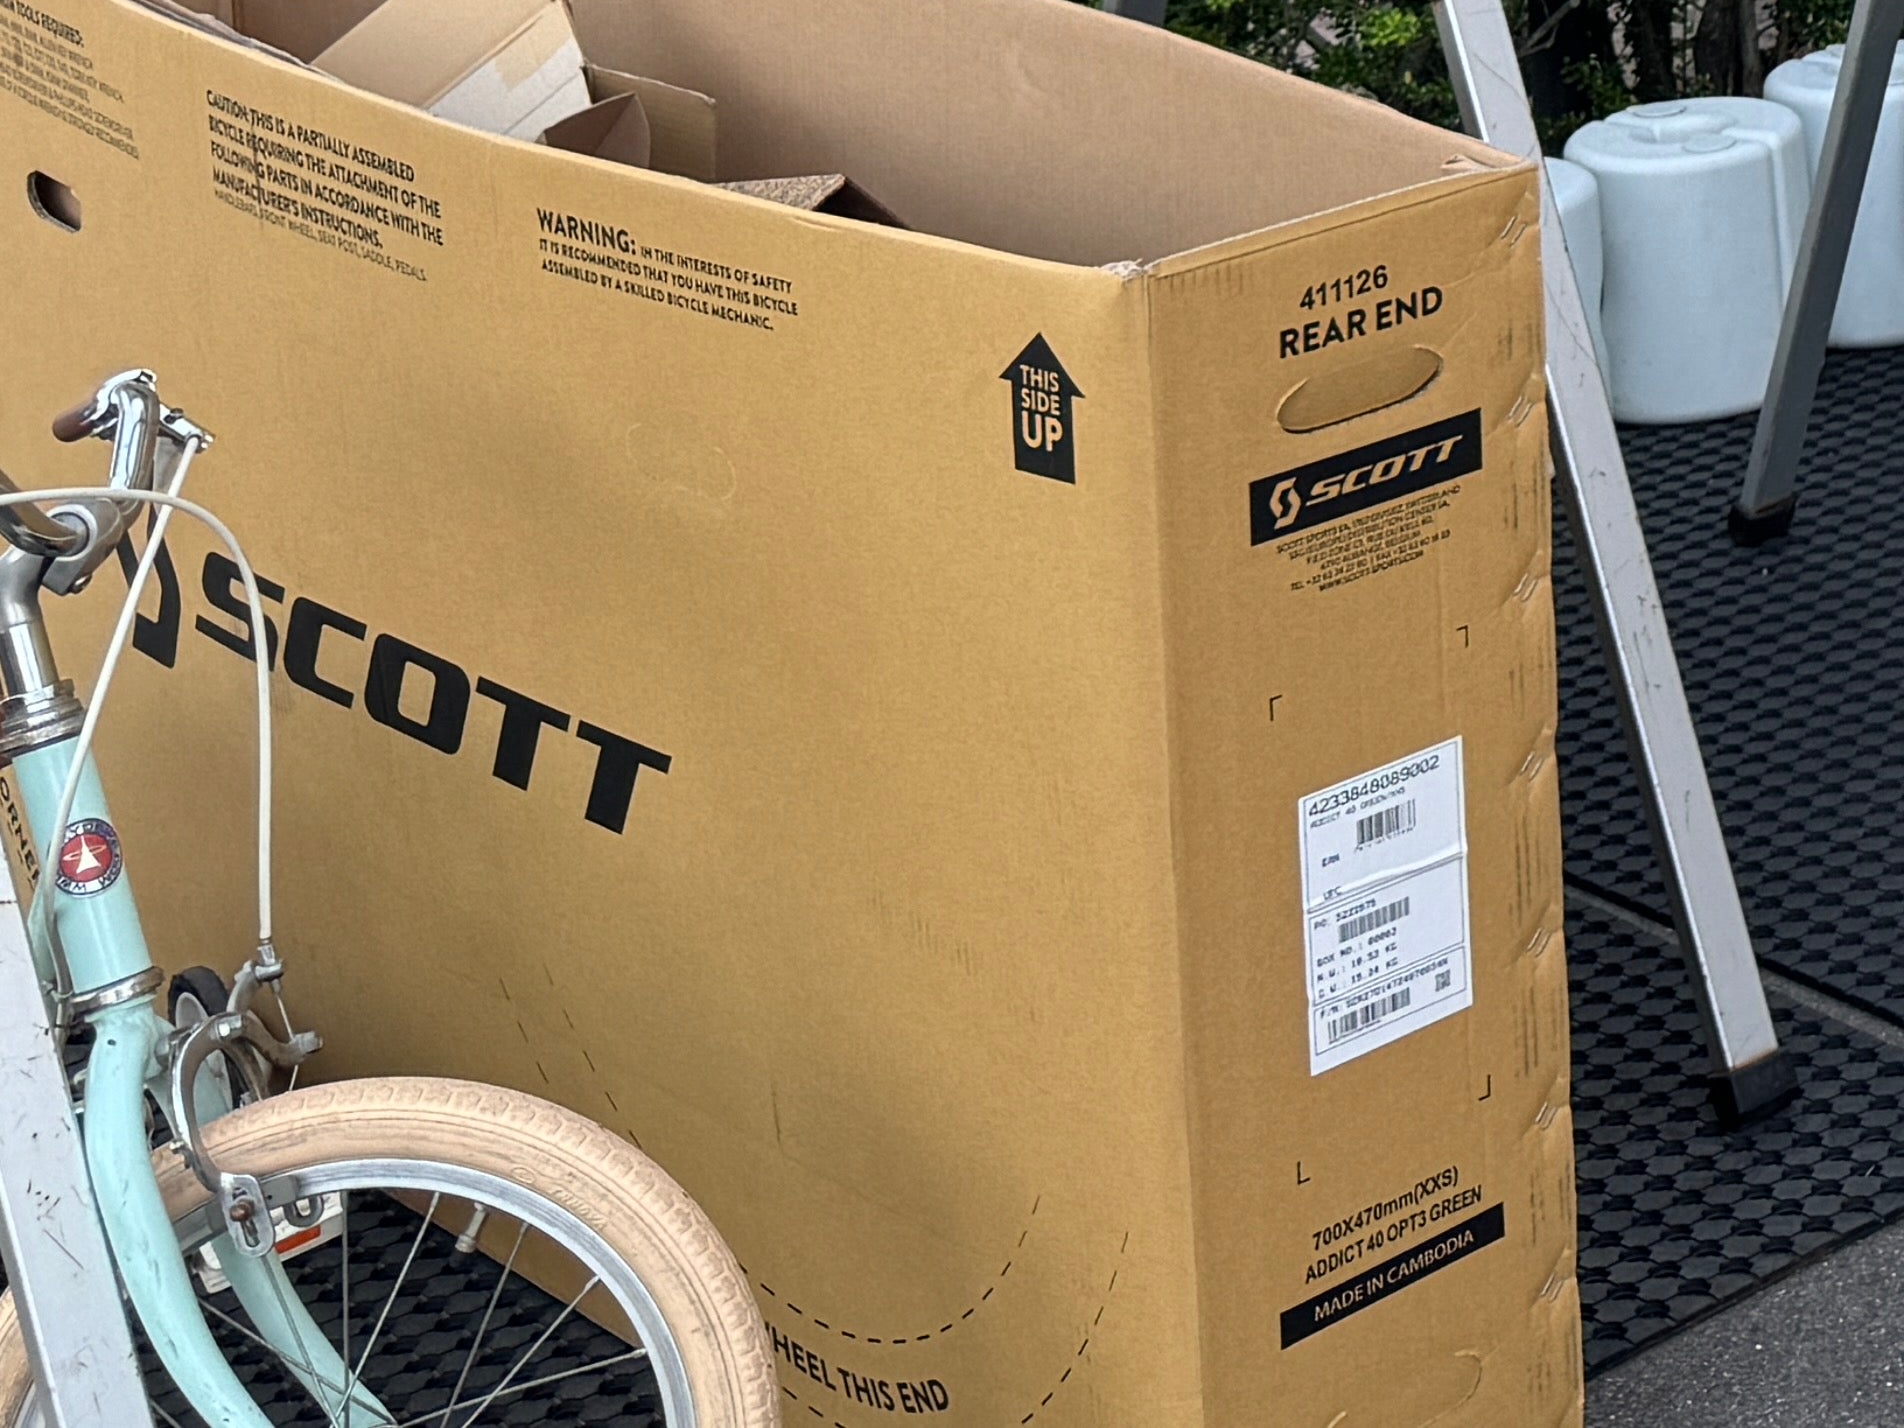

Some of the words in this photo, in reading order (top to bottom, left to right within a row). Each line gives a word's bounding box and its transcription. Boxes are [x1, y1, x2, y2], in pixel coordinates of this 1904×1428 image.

[208, 114, 245, 145] BICYCLE
[246, 132, 304, 169] REQUIRING
[305, 153, 326, 176] THE
[328, 162, 399, 204] ATTACHMENT
[418, 196, 441, 219] THE
[250, 109, 273, 131] THIS
[297, 125, 350, 158] PARTIALLY
[352, 146, 415, 182] ASSEMBLED
[211, 140, 265, 180] FOLLOWING
[267, 164, 299, 191] PARTS
[315, 184, 389, 226] ACCORDANCE
[390, 211, 421, 238] WITH
[421, 222, 443, 246] THE
[536, 207, 637, 255] WARNING:
[655, 248, 675, 266] THE
[676, 254, 731, 281] INTERESTS
[734, 269, 749, 284] OF
[752, 273, 792, 294] SAFETY
[542, 259, 598, 285] ASSEMBLED
[600, 274, 613, 290] BY
[624, 280, 665, 303] SKILLED
[667, 293, 709, 315] BICYCLE
[561, 244, 642, 276] RECOMMENDED
[643, 265, 669, 284] THAT
[671, 273, 693, 290] YOU
[695, 280, 724, 298] HAVE
[725, 288, 750, 306] THIS
[752, 295, 798, 316] BICYCLE
[1299, 264, 1389, 310] 411126
[1279, 308, 1367, 359] REAR
[1376, 286, 1443, 332] END
[1019, 364, 1060, 393] THIS
[1021, 388, 1061, 416] SIDE
[1021, 410, 1063, 452] UP
[1305, 434, 1463, 507] SCOTT
[195, 551, 673, 835] SCOTT
[1305, 1236, 1364, 1285] ADDICT
[1366, 1230, 1385, 1253] 40
[1387, 1210, 1427, 1243] OPT3
[1429, 1184, 1482, 1222] GREEN
[1312, 1165, 1459, 1252] 700X470mm(XXS)
[1314, 1283, 1364, 1322] MADE
[1366, 1273, 1384, 1296] IN
[1386, 1229, 1474, 1285] CAMBODIA
[765, 1321, 837, 1392] HEEL
[836, 1366, 896, 1412] THIS
[896, 1378, 949, 1414] END
